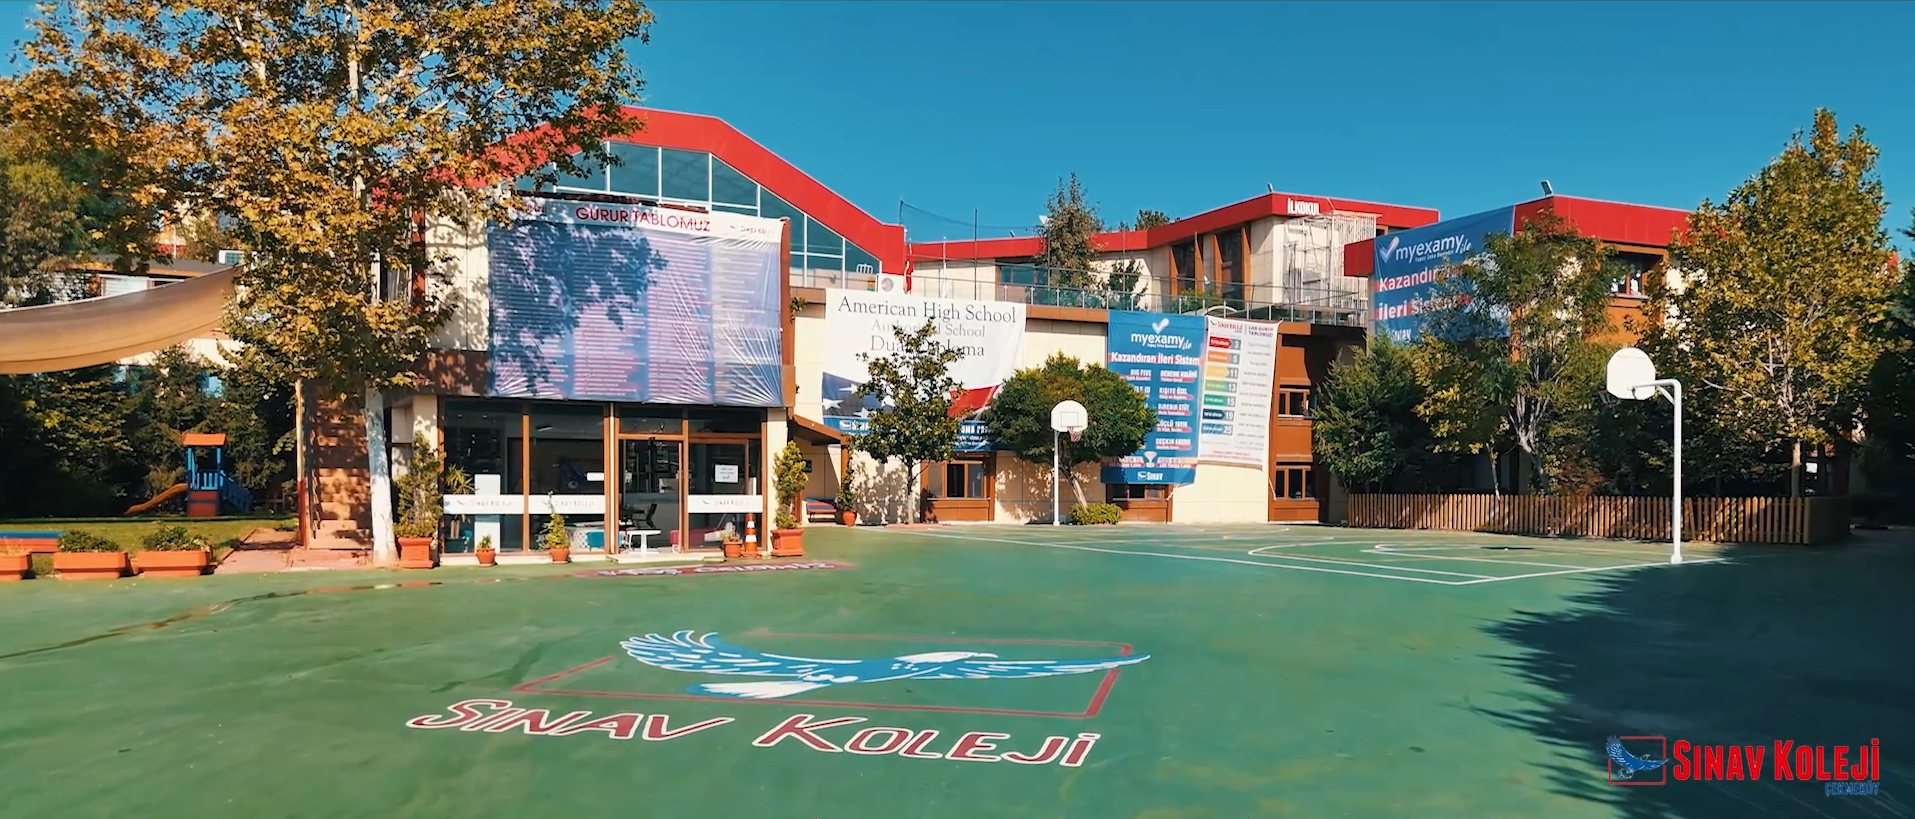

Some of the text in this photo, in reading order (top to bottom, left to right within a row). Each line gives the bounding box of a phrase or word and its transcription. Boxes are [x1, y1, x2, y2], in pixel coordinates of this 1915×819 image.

[575, 206, 711, 232] GURUR TABLOMUZ
[1395, 234, 1464, 263] myexamy
[1379, 266, 1457, 292] Kazandır
[838, 296, 1016, 323] American High School
[945, 323, 985, 338] School
[1130, 333, 1185, 350] myexamy
[918, 337, 985, 359] Dploma
[1111, 352, 1157, 364] Kazandıran
[1175, 354, 1200, 366] Sistem
[405, 697, 1102, 768] SINAV KOLEJİ
